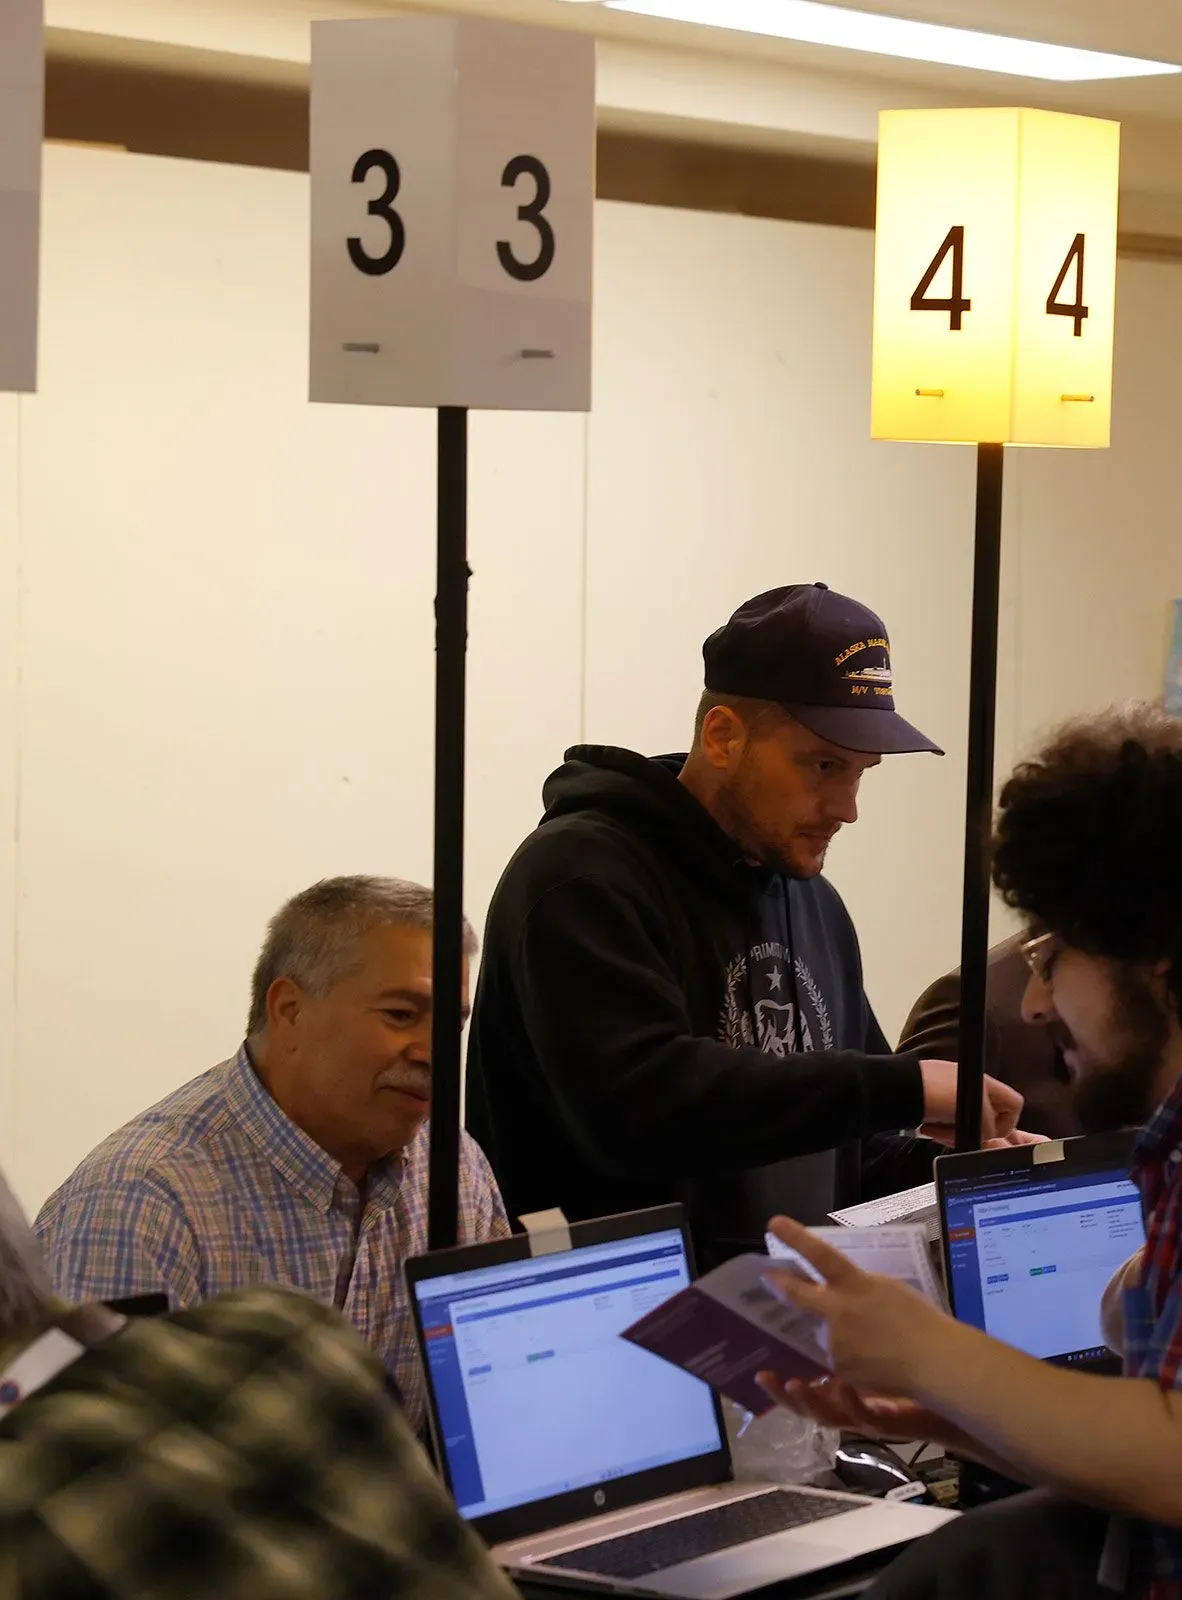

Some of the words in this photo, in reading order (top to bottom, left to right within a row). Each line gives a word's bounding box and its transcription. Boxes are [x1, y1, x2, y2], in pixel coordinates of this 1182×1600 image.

[346, 148, 406, 277] 3
[495, 154, 555, 282] 3
[910, 225, 971, 331] 4
[1045, 233, 1089, 337] 4
[833, 641, 867, 667] ALASKA
